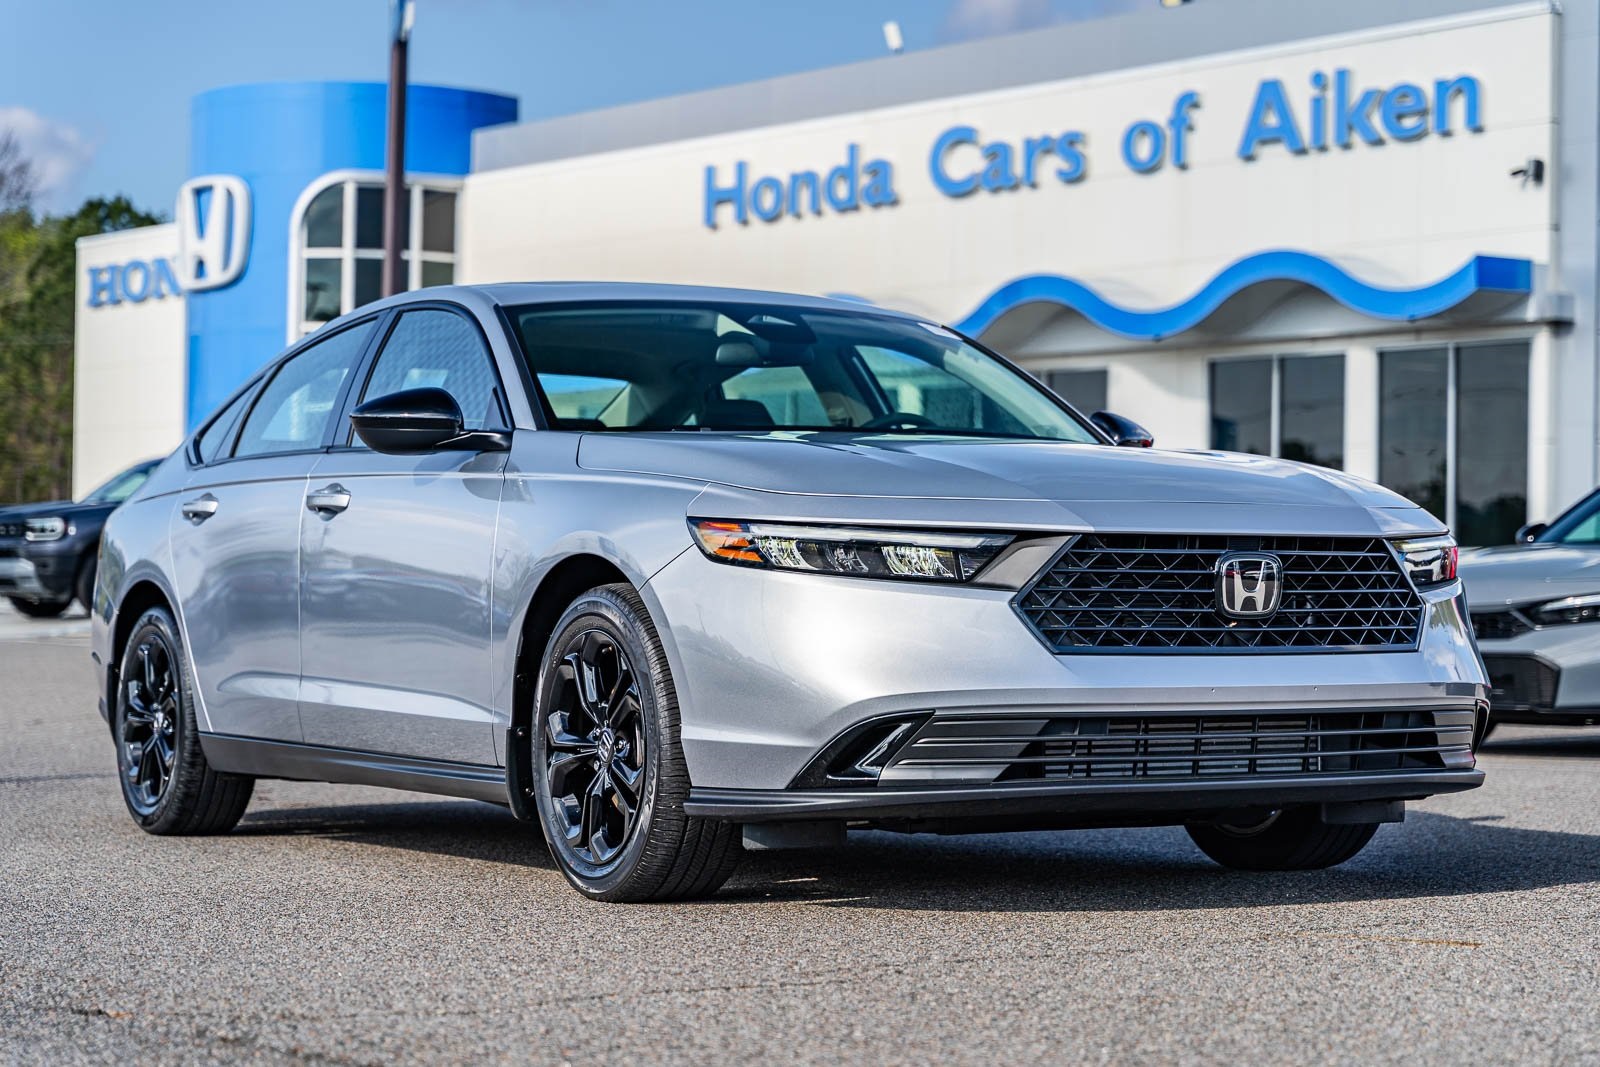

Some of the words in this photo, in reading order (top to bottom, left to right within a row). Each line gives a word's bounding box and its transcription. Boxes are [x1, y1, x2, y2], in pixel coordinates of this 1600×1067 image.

[703, 142, 898, 228] Honda
[929, 125, 1086, 198] Cars
[1121, 90, 1200, 173] of
[1237, 67, 1483, 161] Aiken
